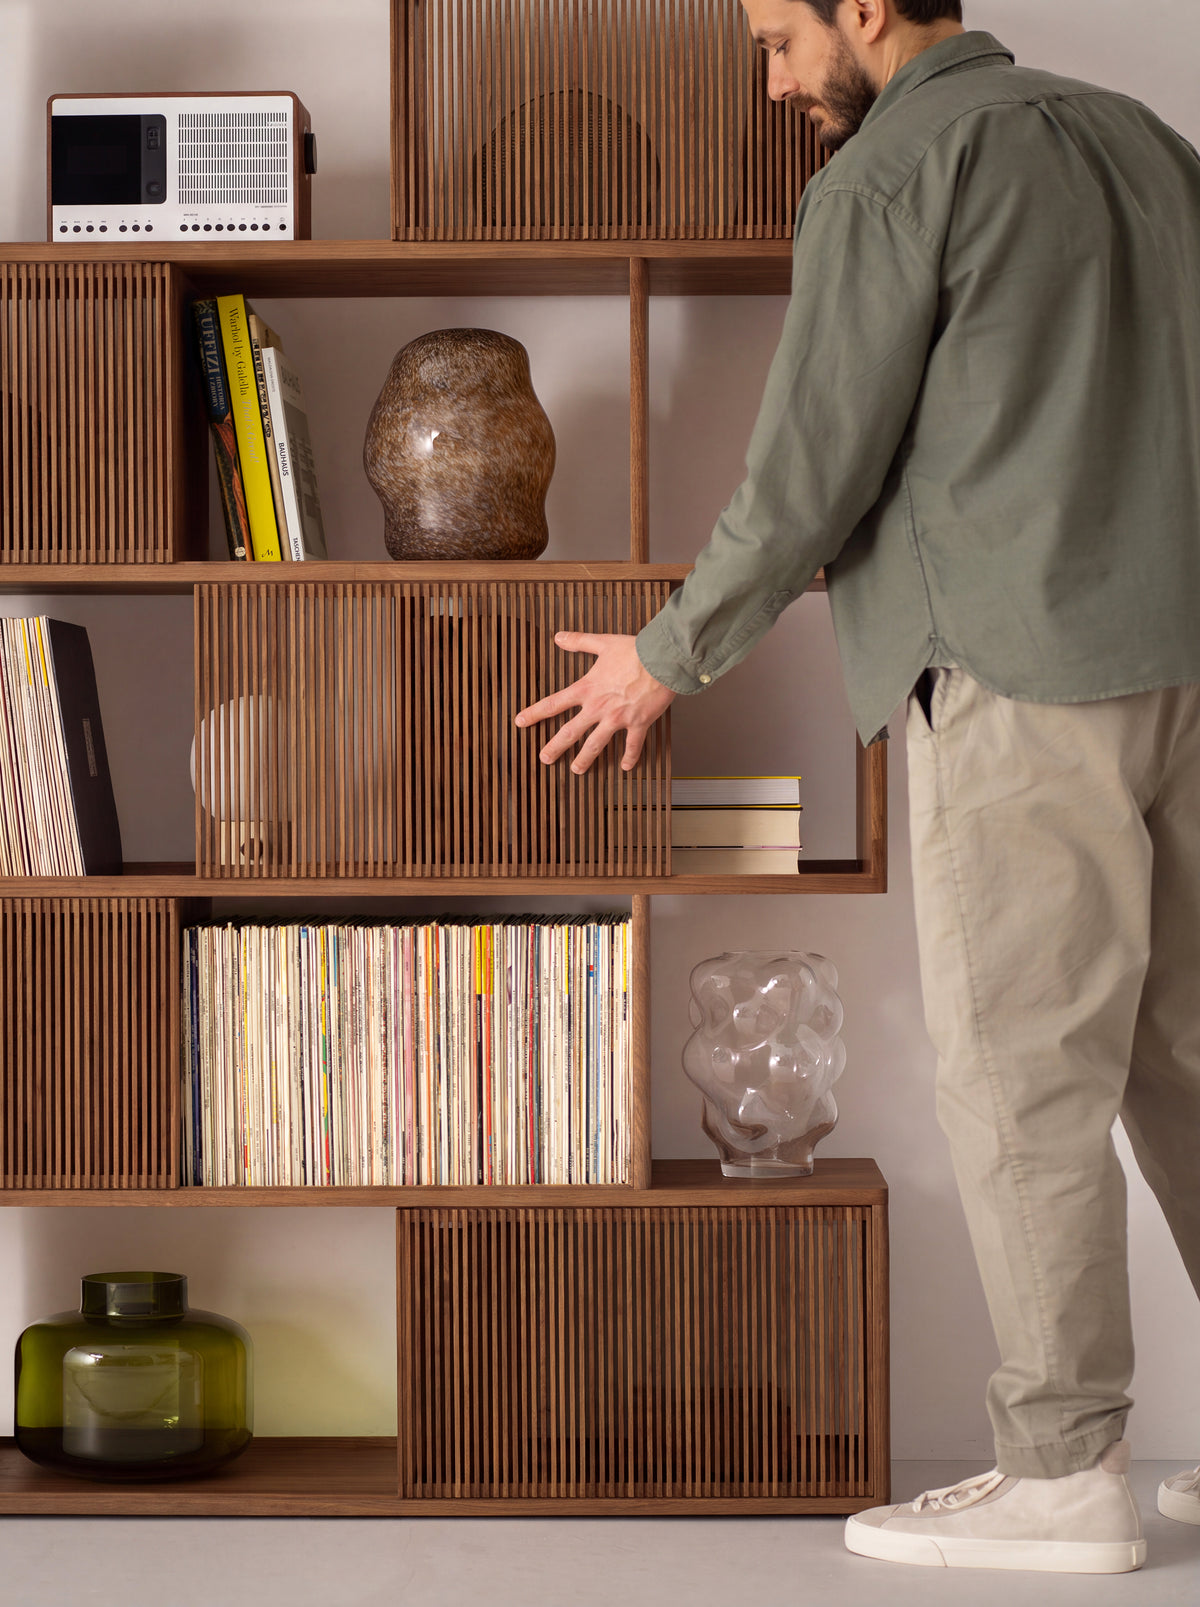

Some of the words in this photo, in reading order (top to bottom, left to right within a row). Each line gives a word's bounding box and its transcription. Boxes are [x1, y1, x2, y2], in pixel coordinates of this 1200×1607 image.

[229, 307, 243, 344] Warhol
[200, 316, 221, 374] UFFIZI
[232, 345, 244, 359] by
[215, 375, 225, 410] HISTORIA
[236, 360, 249, 397] Galella
[278, 442, 290, 477] BAUHAUS
